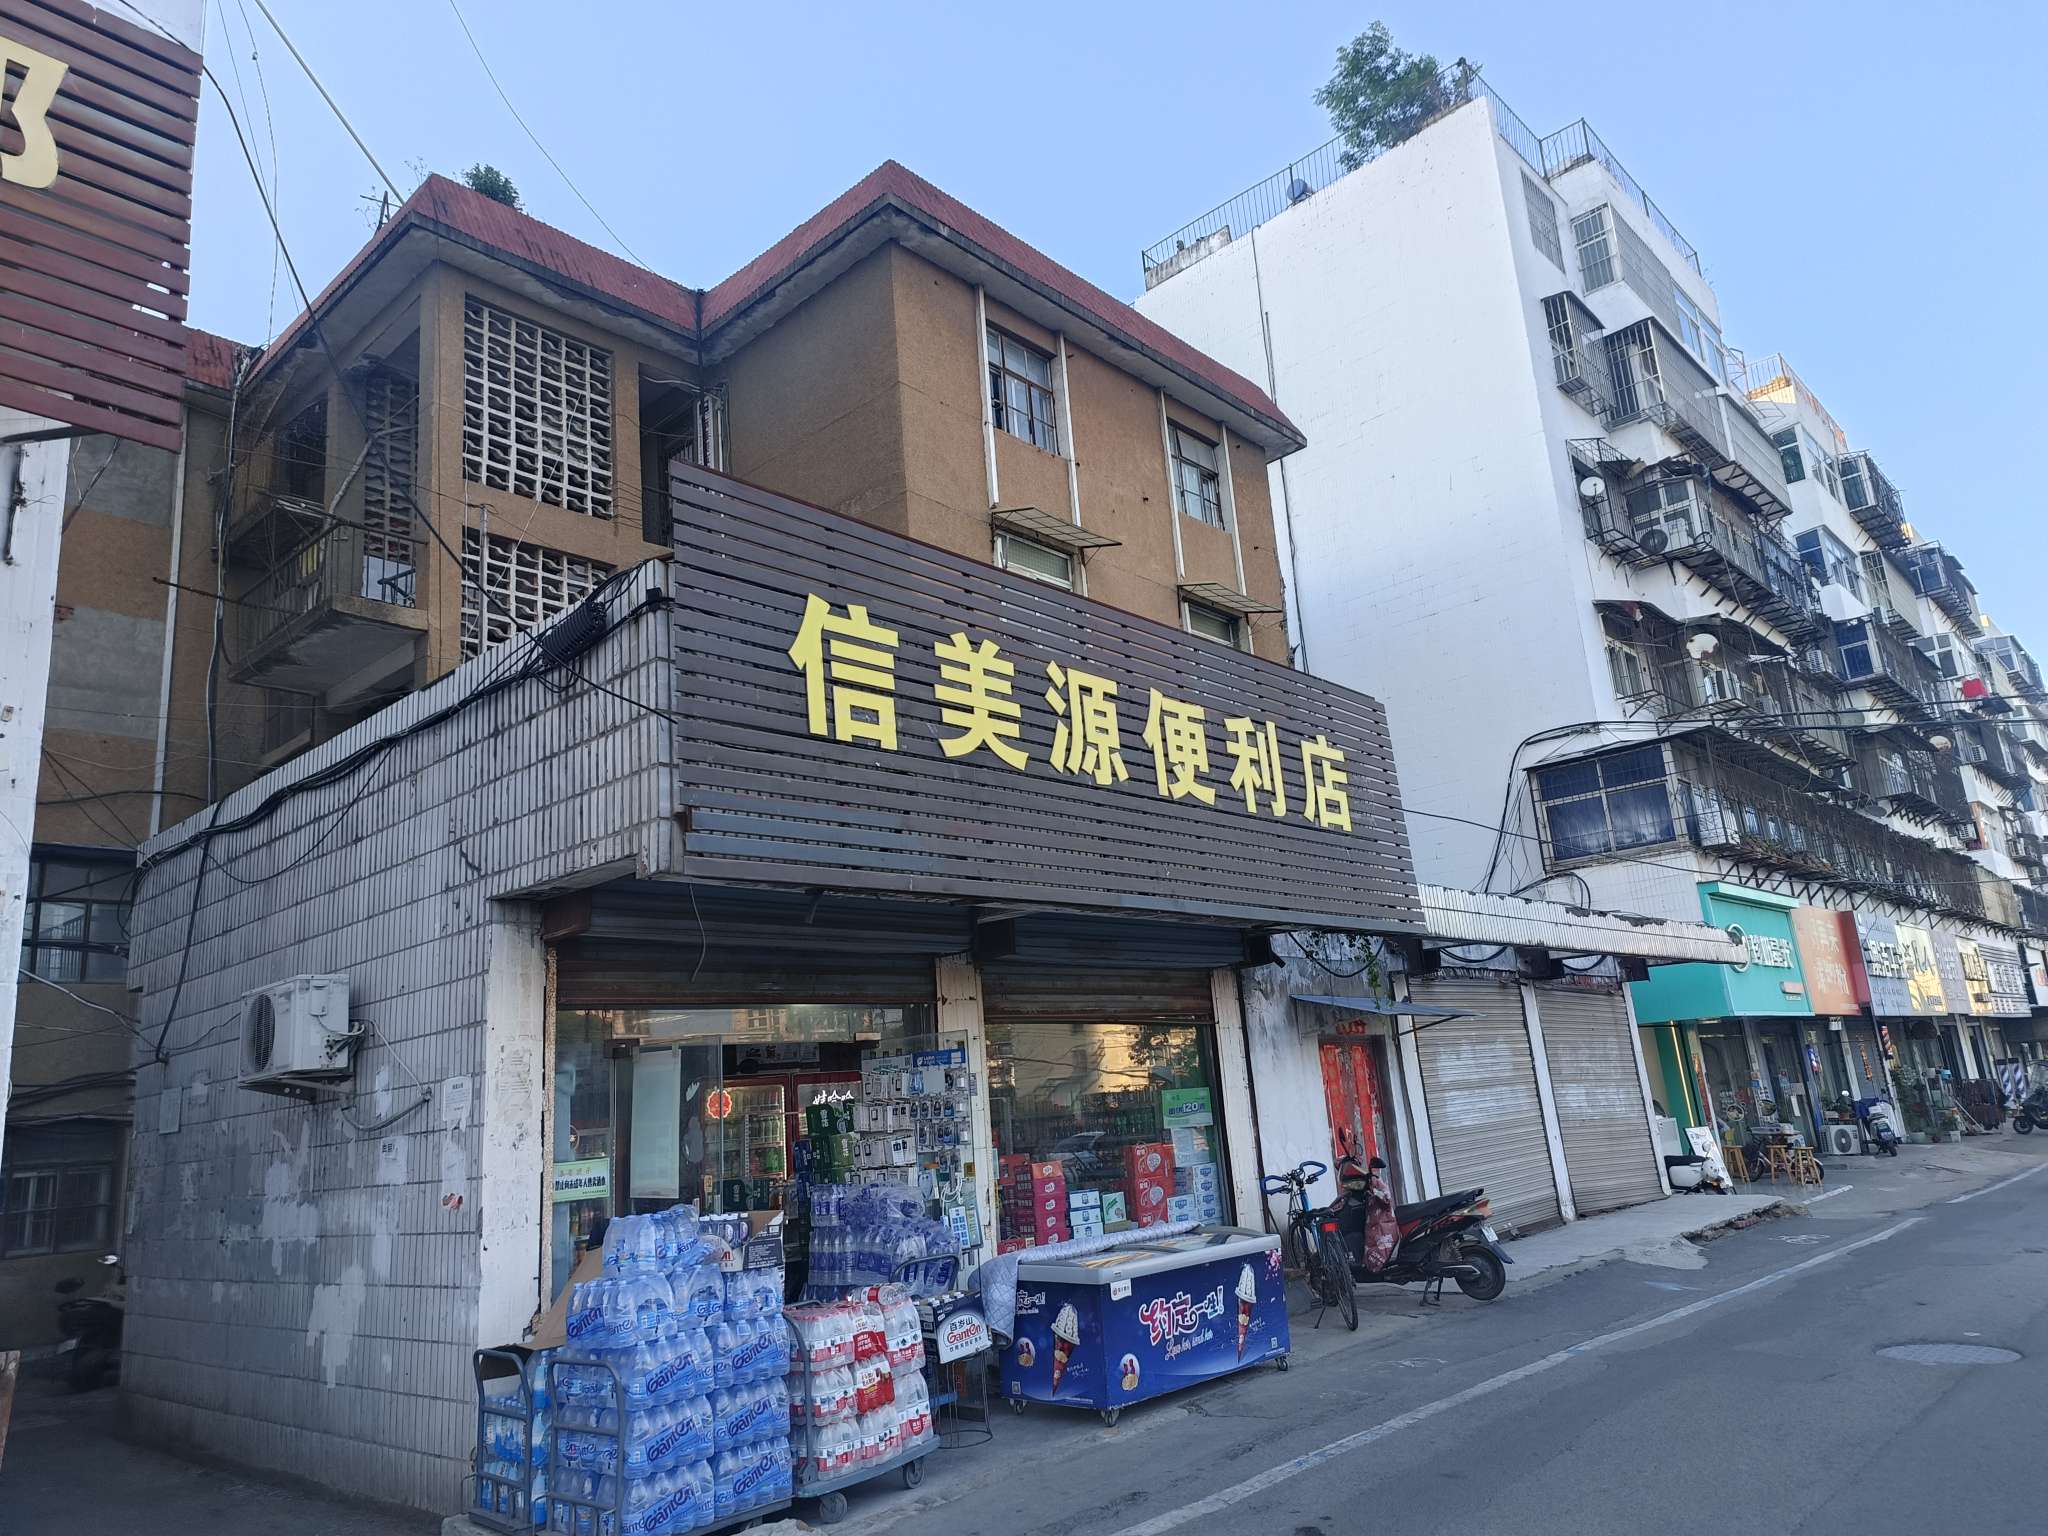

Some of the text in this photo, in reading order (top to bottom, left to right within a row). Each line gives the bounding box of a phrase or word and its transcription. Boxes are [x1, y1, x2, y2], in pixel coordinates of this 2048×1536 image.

[788, 592, 1353, 832] 信美源便利店
[949, 1316, 974, 1332] 百岁山
[732, 1332, 775, 1370] Ganten
[647, 1353, 694, 1394] Ganten
[727, 1397, 771, 1438] Ganten
[647, 1416, 696, 1463] Ganten
[733, 1451, 778, 1496] Ganten
